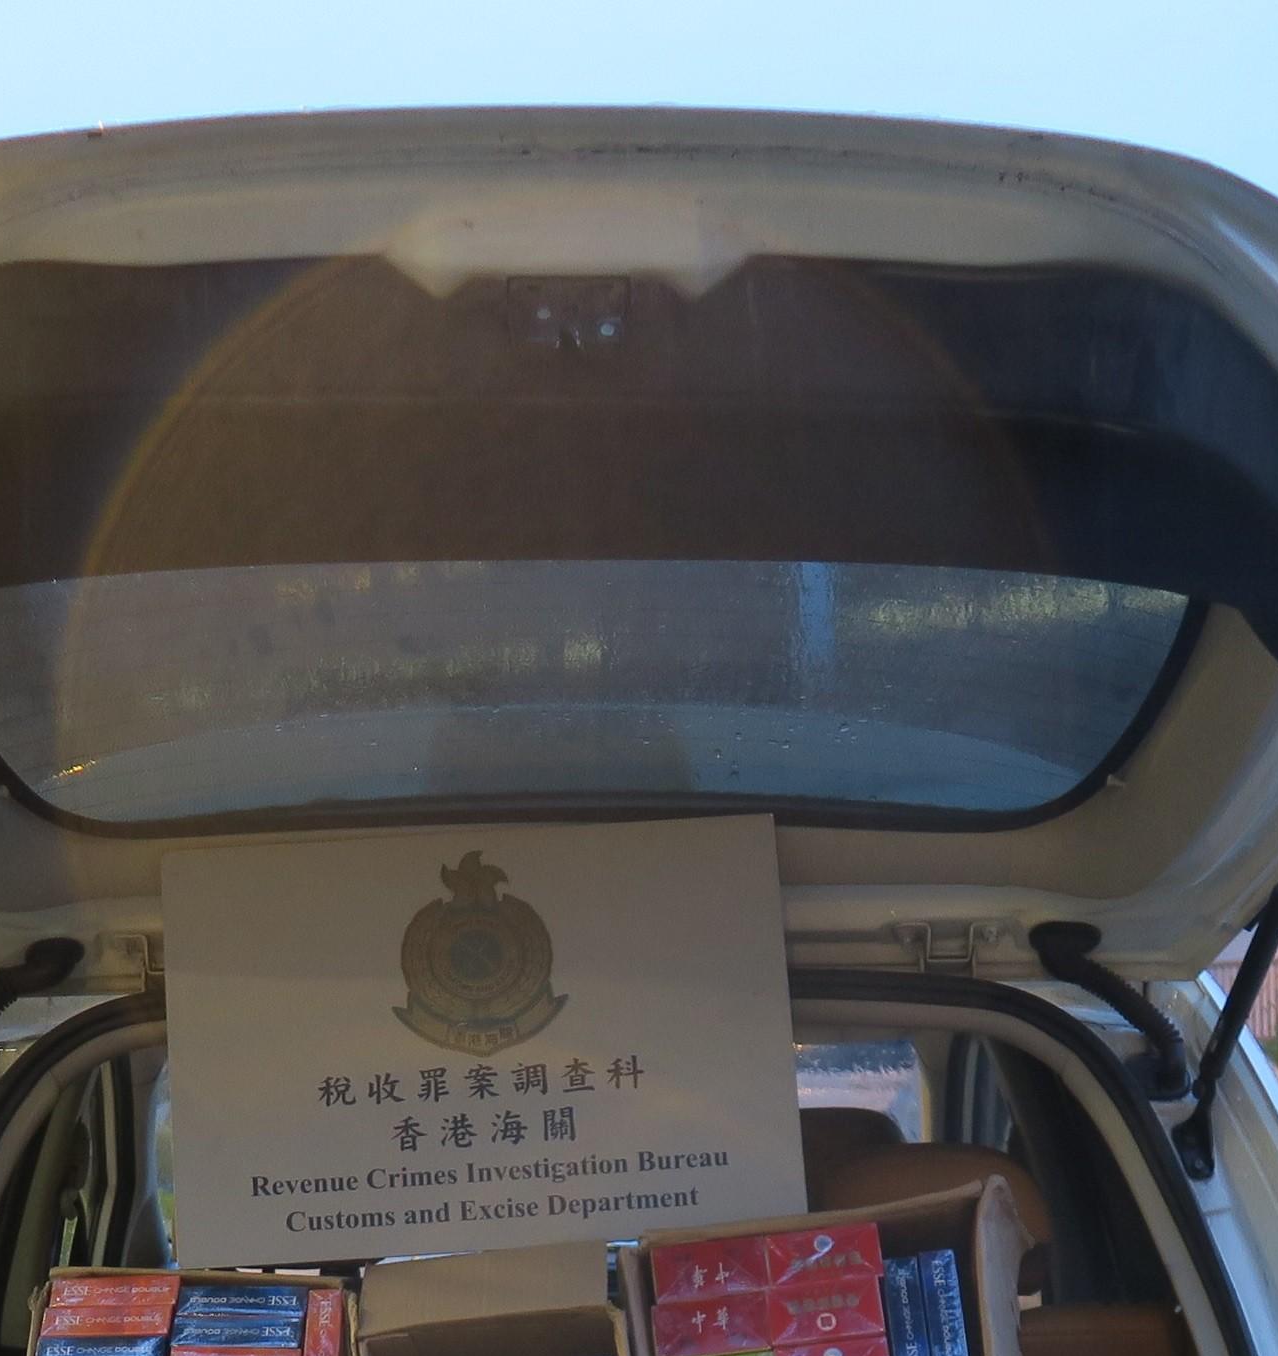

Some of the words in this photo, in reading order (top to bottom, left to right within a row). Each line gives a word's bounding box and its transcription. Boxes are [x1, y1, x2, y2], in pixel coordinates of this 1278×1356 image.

[392, 1106, 576, 1151] 香港海關
[251, 1170, 358, 1198] Revenue
[366, 1165, 458, 1191] Crimes
[465, 1153, 628, 1184] Investigation
[638, 1147, 729, 1172] Bureau
[285, 1209, 396, 1234] Customs
[403, 1201, 450, 1224] and
[459, 1196, 540, 1221] Excise
[547, 1186, 699, 1218] Department
[268, 1296, 298, 1306] ESSE
[46, 1345, 74, 1356] ESSE
